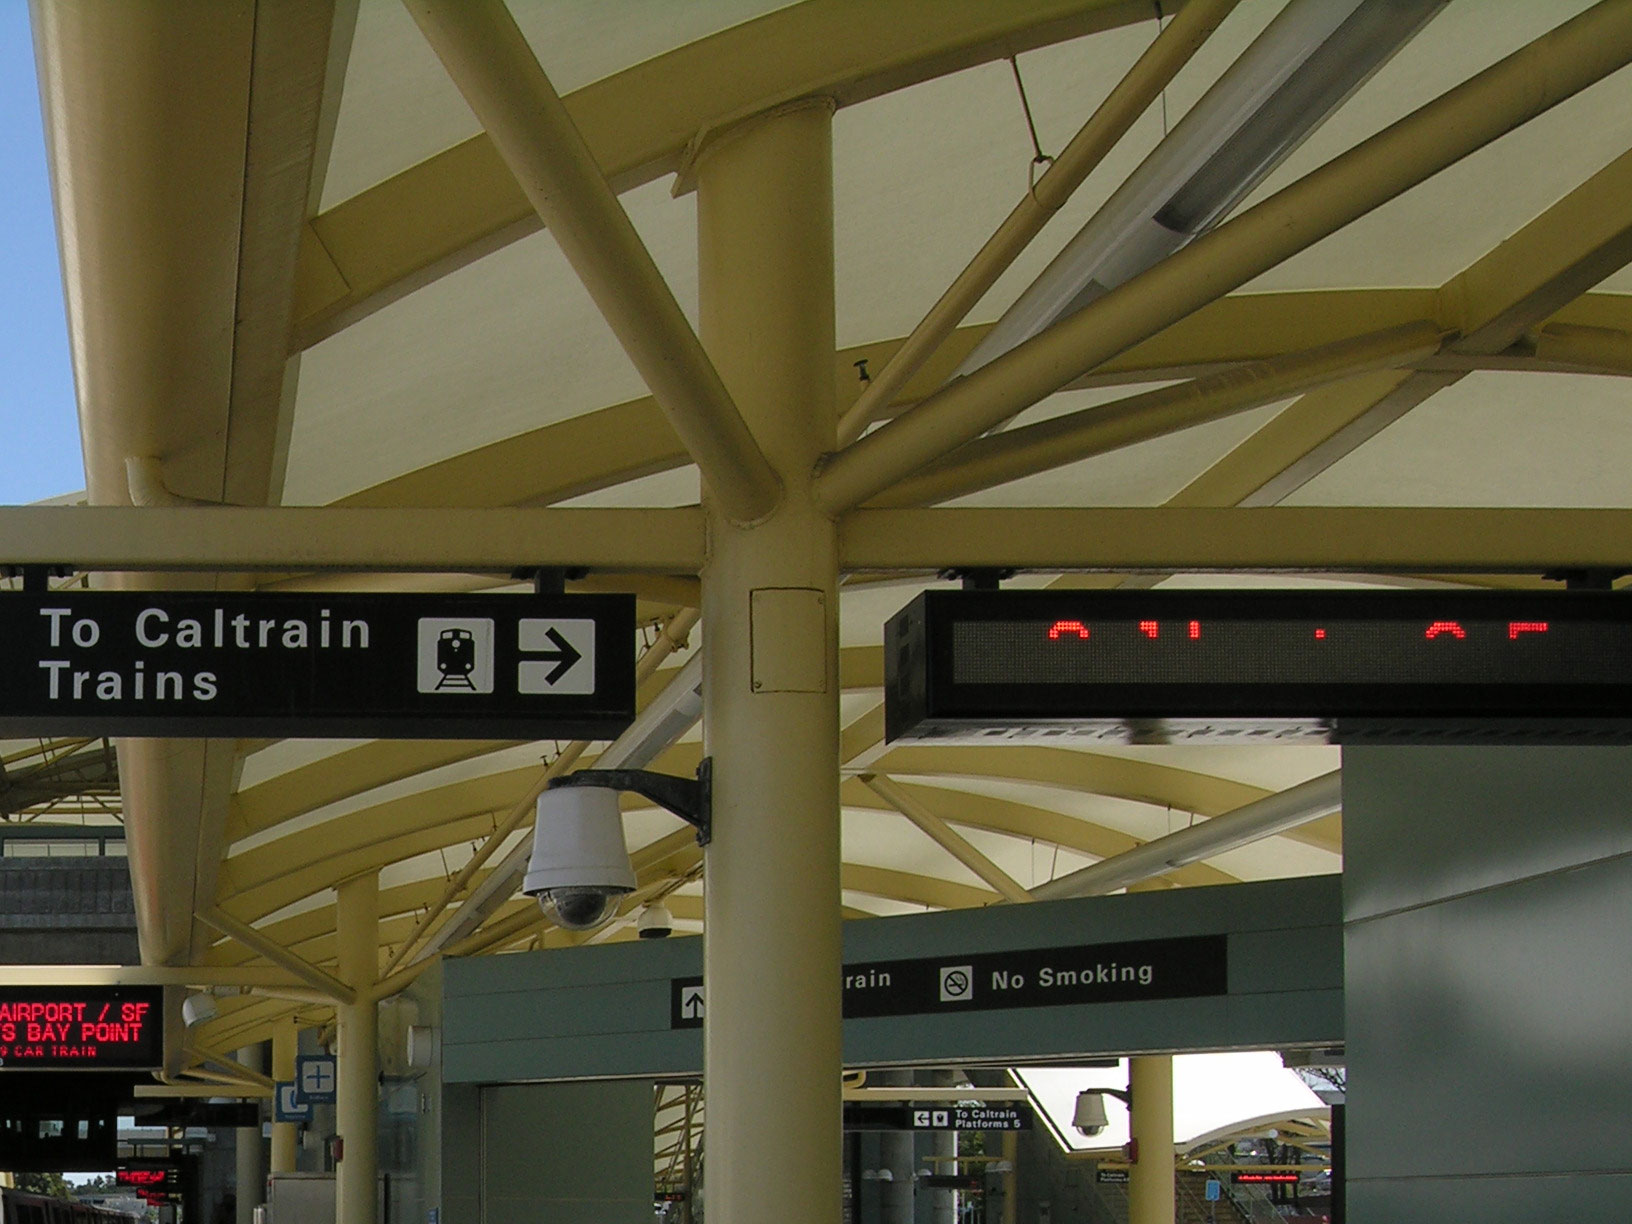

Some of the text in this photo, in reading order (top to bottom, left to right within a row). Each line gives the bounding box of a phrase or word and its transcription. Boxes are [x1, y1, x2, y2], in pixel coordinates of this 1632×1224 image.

[39, 608, 369, 649] To Caltrain
[39, 660, 218, 701] Trains
[846, 969, 891, 989] rain
[992, 963, 1153, 990] No Smoking
[121, 1002, 150, 1022] SF
[27, 1022, 71, 1042] BAY
[81, 1022, 143, 1042] POINT
[13, 1045, 44, 1057] CAR
[52, 1045, 96, 1057] TRAIN
[955, 1119, 1009, 1128] Platforms
[956, 1109, 1017, 1119] To Caltrain
